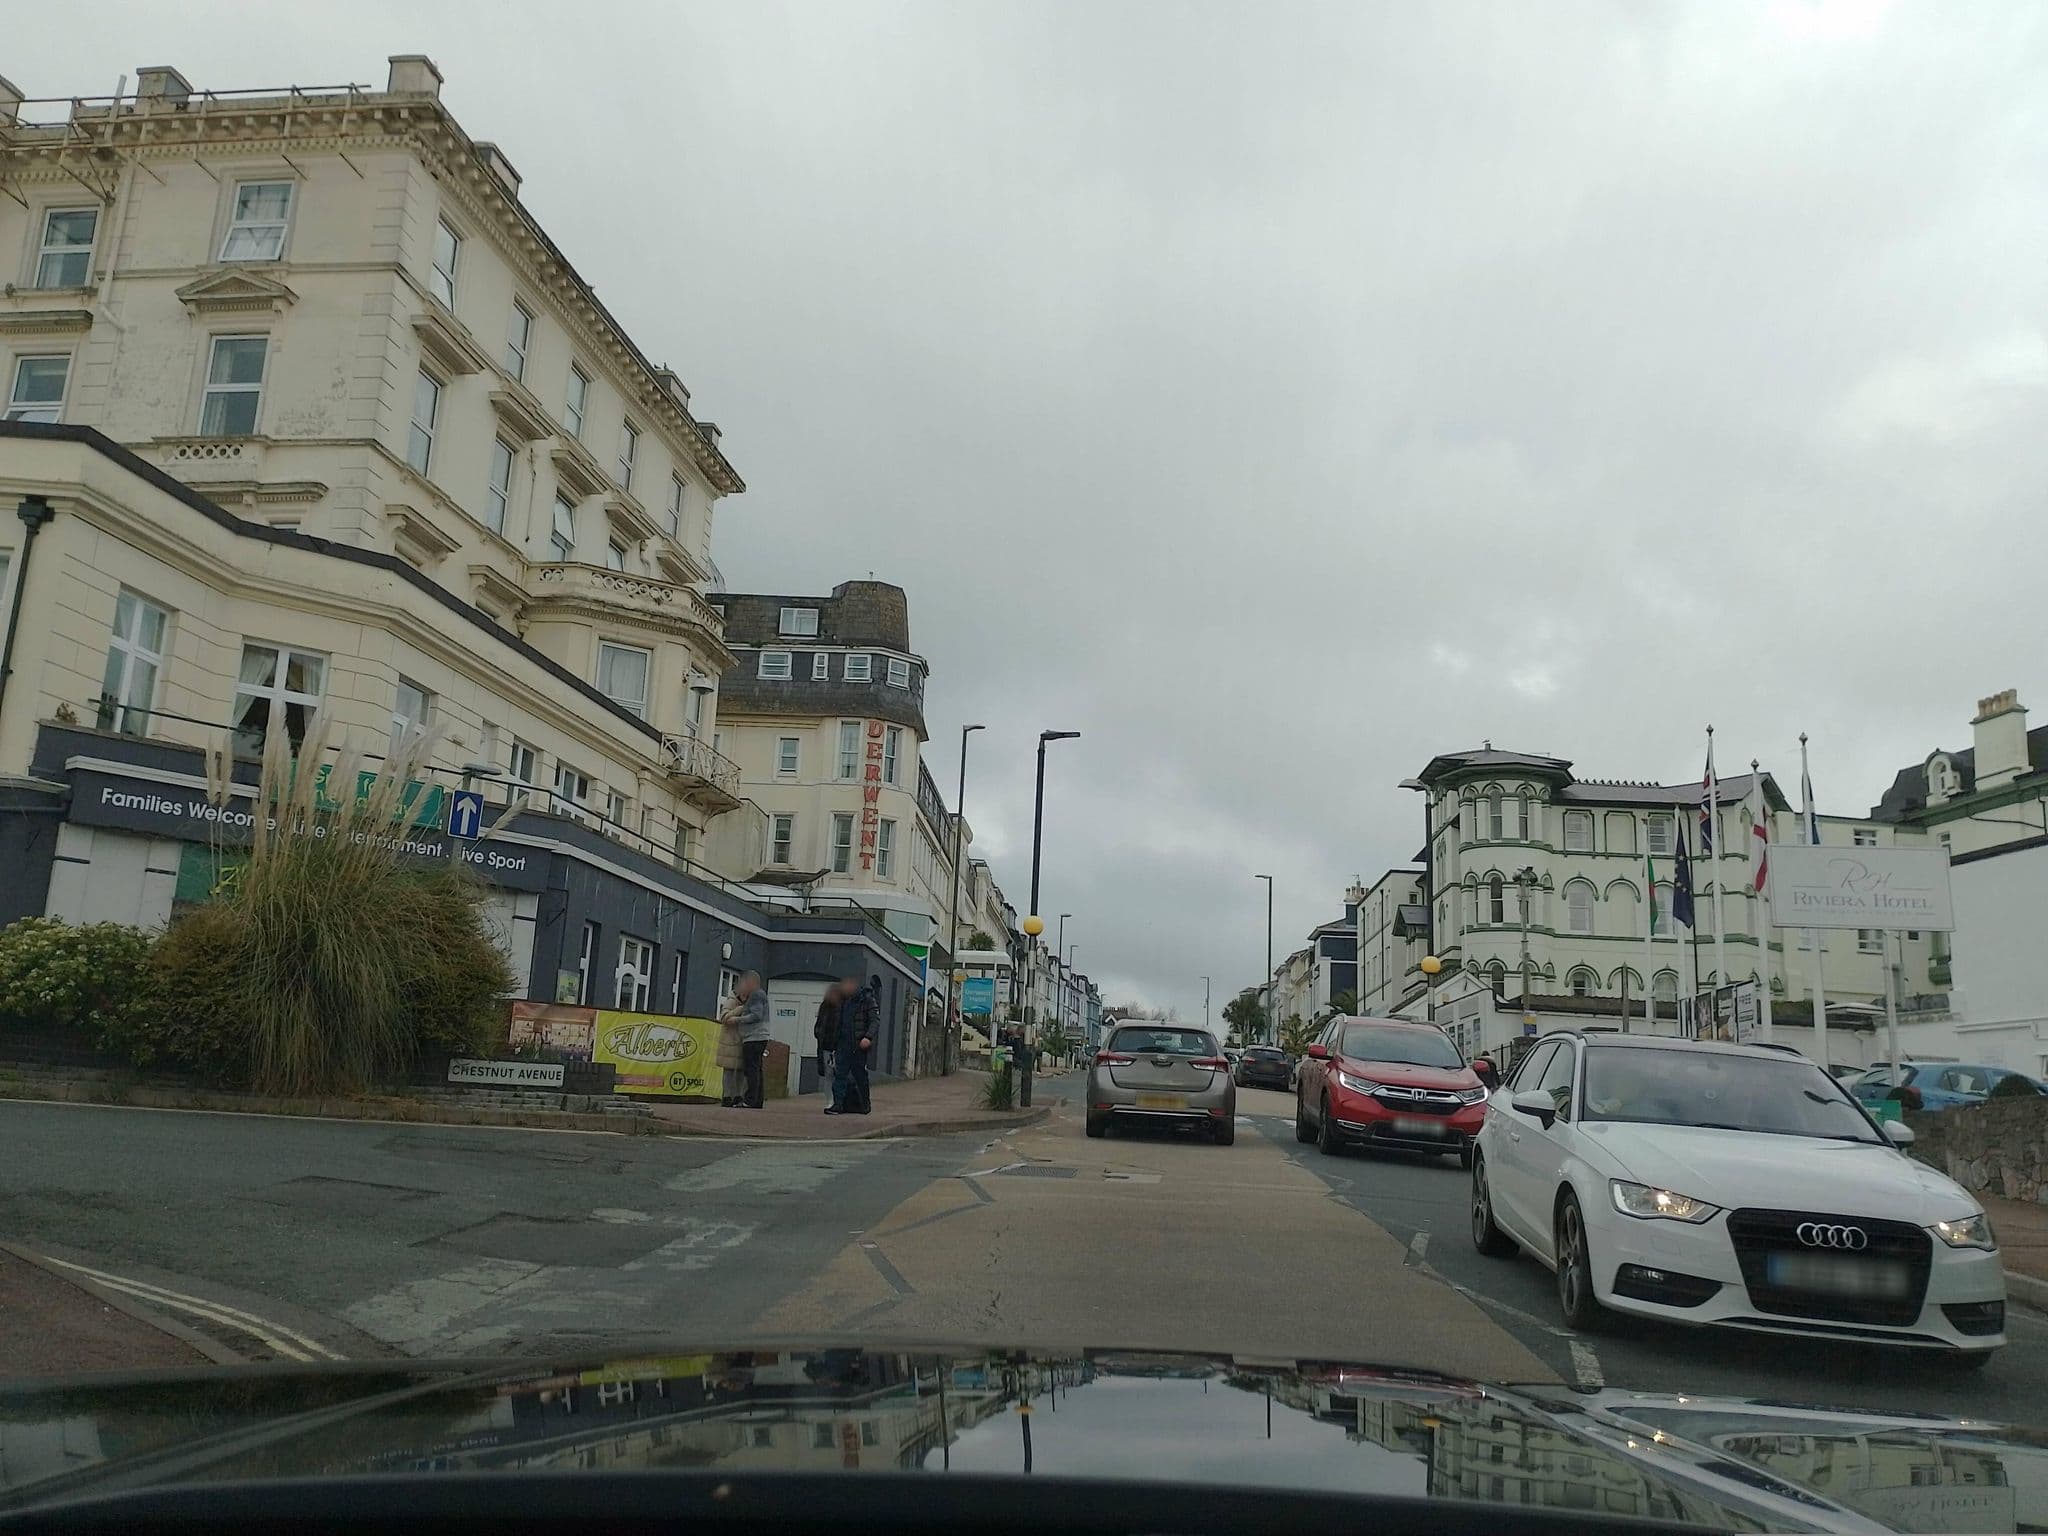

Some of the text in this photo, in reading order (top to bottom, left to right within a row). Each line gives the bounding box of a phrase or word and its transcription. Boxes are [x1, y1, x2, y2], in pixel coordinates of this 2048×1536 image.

[859, 720, 884, 870] DERWENT
[101, 787, 183, 816] Families
[293, 814, 326, 838] Lie
[460, 846, 485, 864] ive
[487, 851, 526, 871] Sport
[608, 1022, 691, 1058] Alberts
[452, 1065, 562, 1081] CHESTNUT AVENUE
